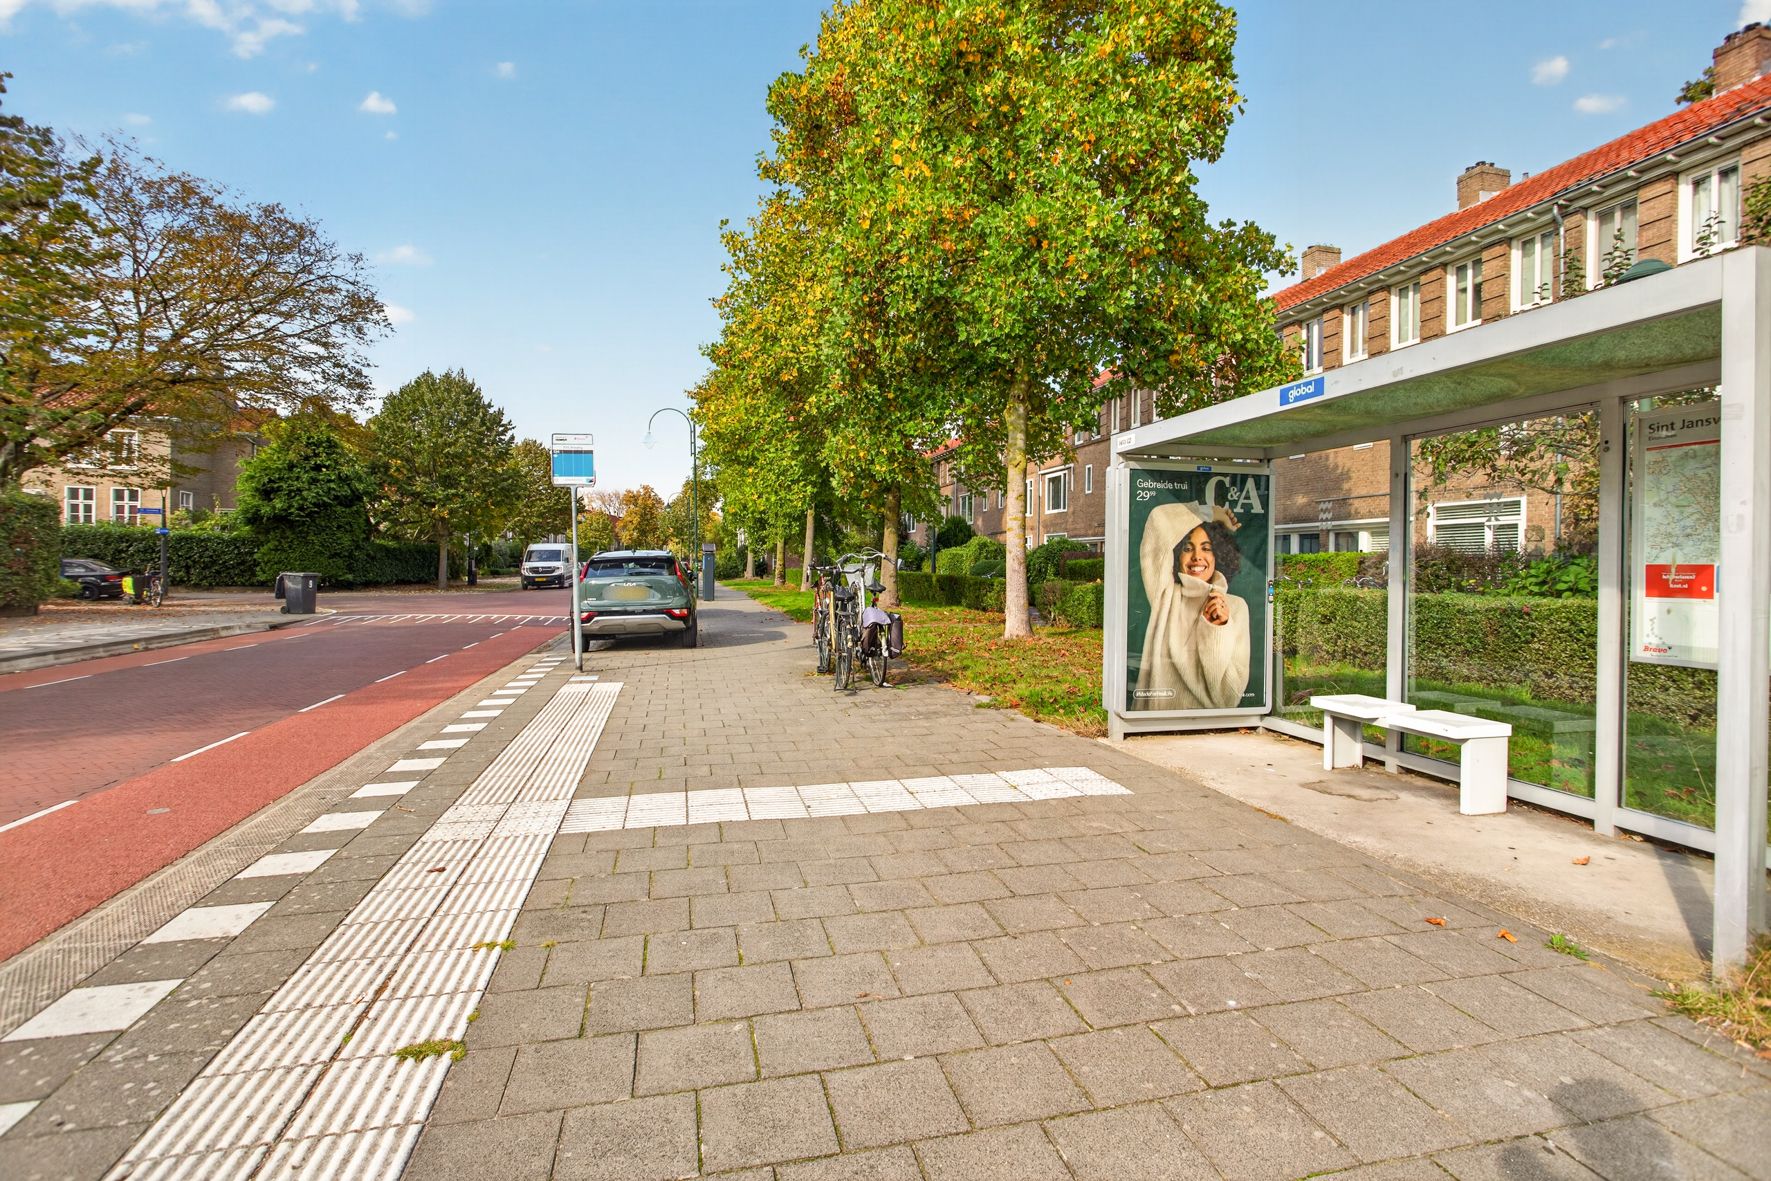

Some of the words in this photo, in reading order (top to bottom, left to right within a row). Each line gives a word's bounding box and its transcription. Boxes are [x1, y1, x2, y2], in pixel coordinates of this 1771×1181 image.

[1288, 381, 1315, 402] global
[1648, 422, 1675, 434] Sint
[1136, 478, 1173, 490] Gebreide
[1174, 481, 1188, 490] trui
[1205, 476, 1264, 513] C&A
